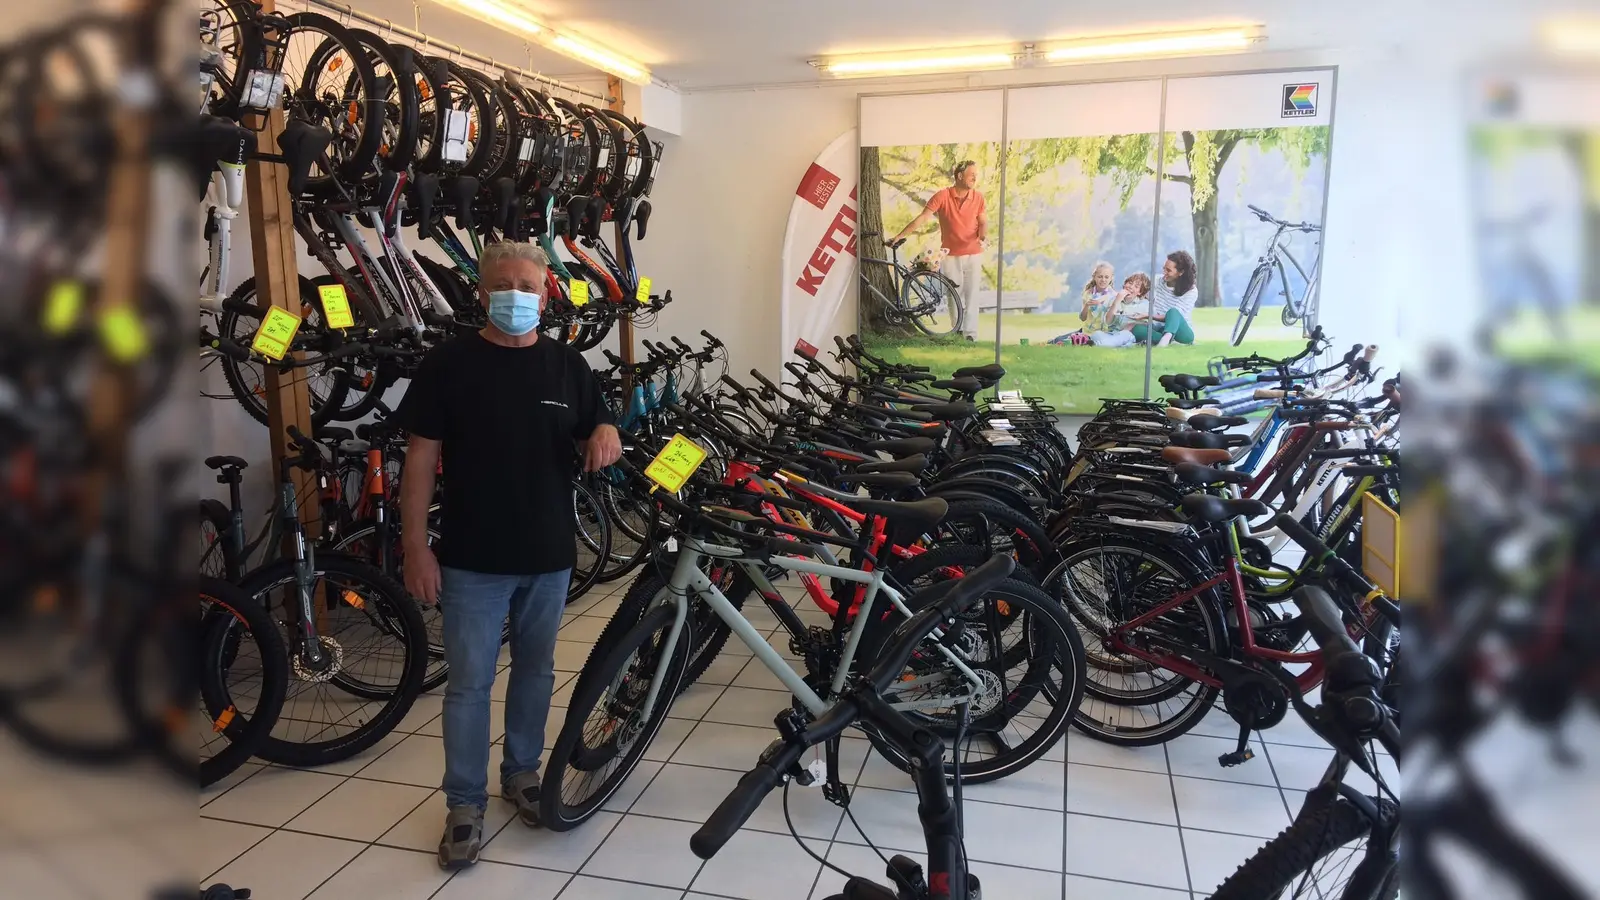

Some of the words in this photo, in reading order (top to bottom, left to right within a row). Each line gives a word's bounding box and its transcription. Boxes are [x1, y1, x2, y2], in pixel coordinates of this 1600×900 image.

[237, 138, 245, 177] DAHON
[813, 179, 828, 197] HIER
[817, 179, 837, 205] TESTEN
[795, 184, 858, 297] KETTL
